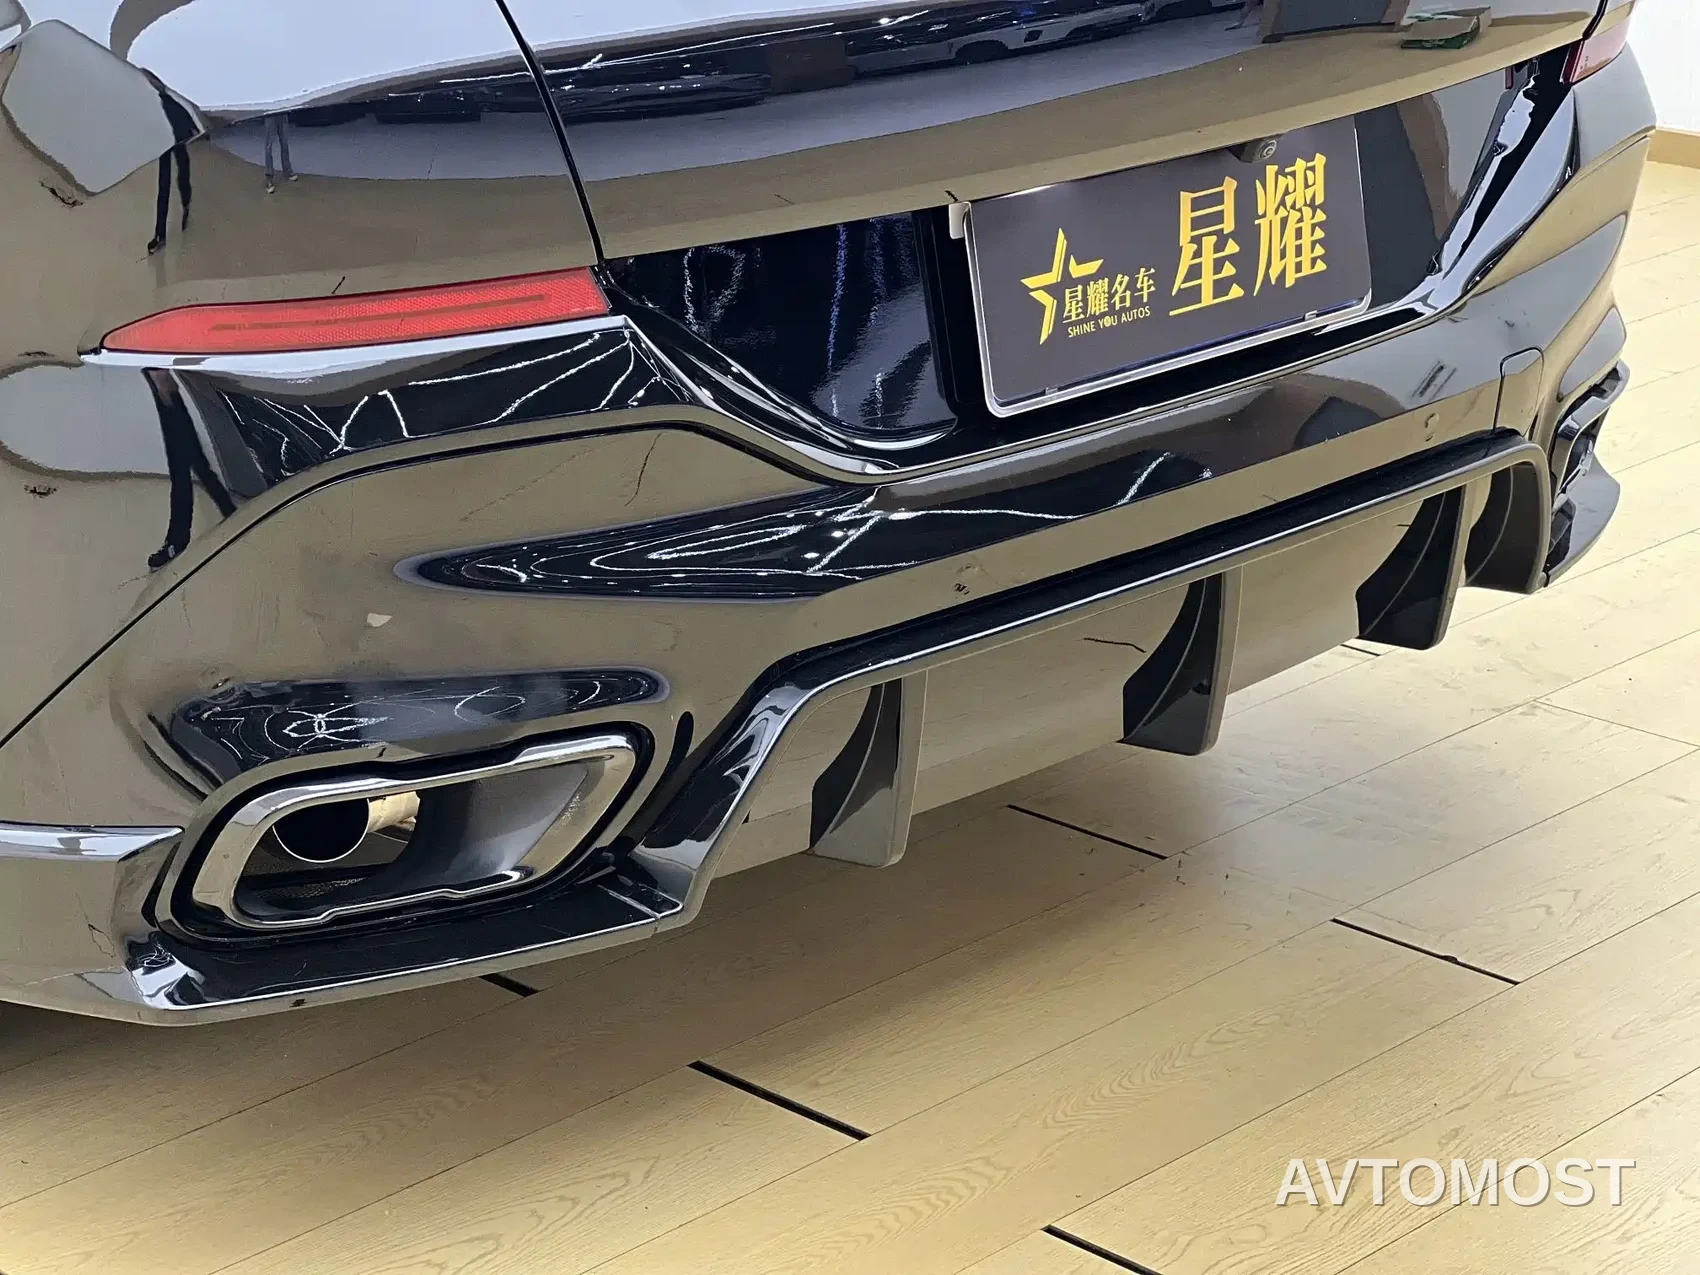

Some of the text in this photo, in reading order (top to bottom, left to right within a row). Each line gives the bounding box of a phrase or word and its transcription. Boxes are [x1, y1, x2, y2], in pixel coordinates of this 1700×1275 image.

[1169, 152, 1327, 316] 星耀
[1062, 267, 1156, 323] 星耀名车
[1067, 305, 1151, 338] SHINE YOU AUTOS
